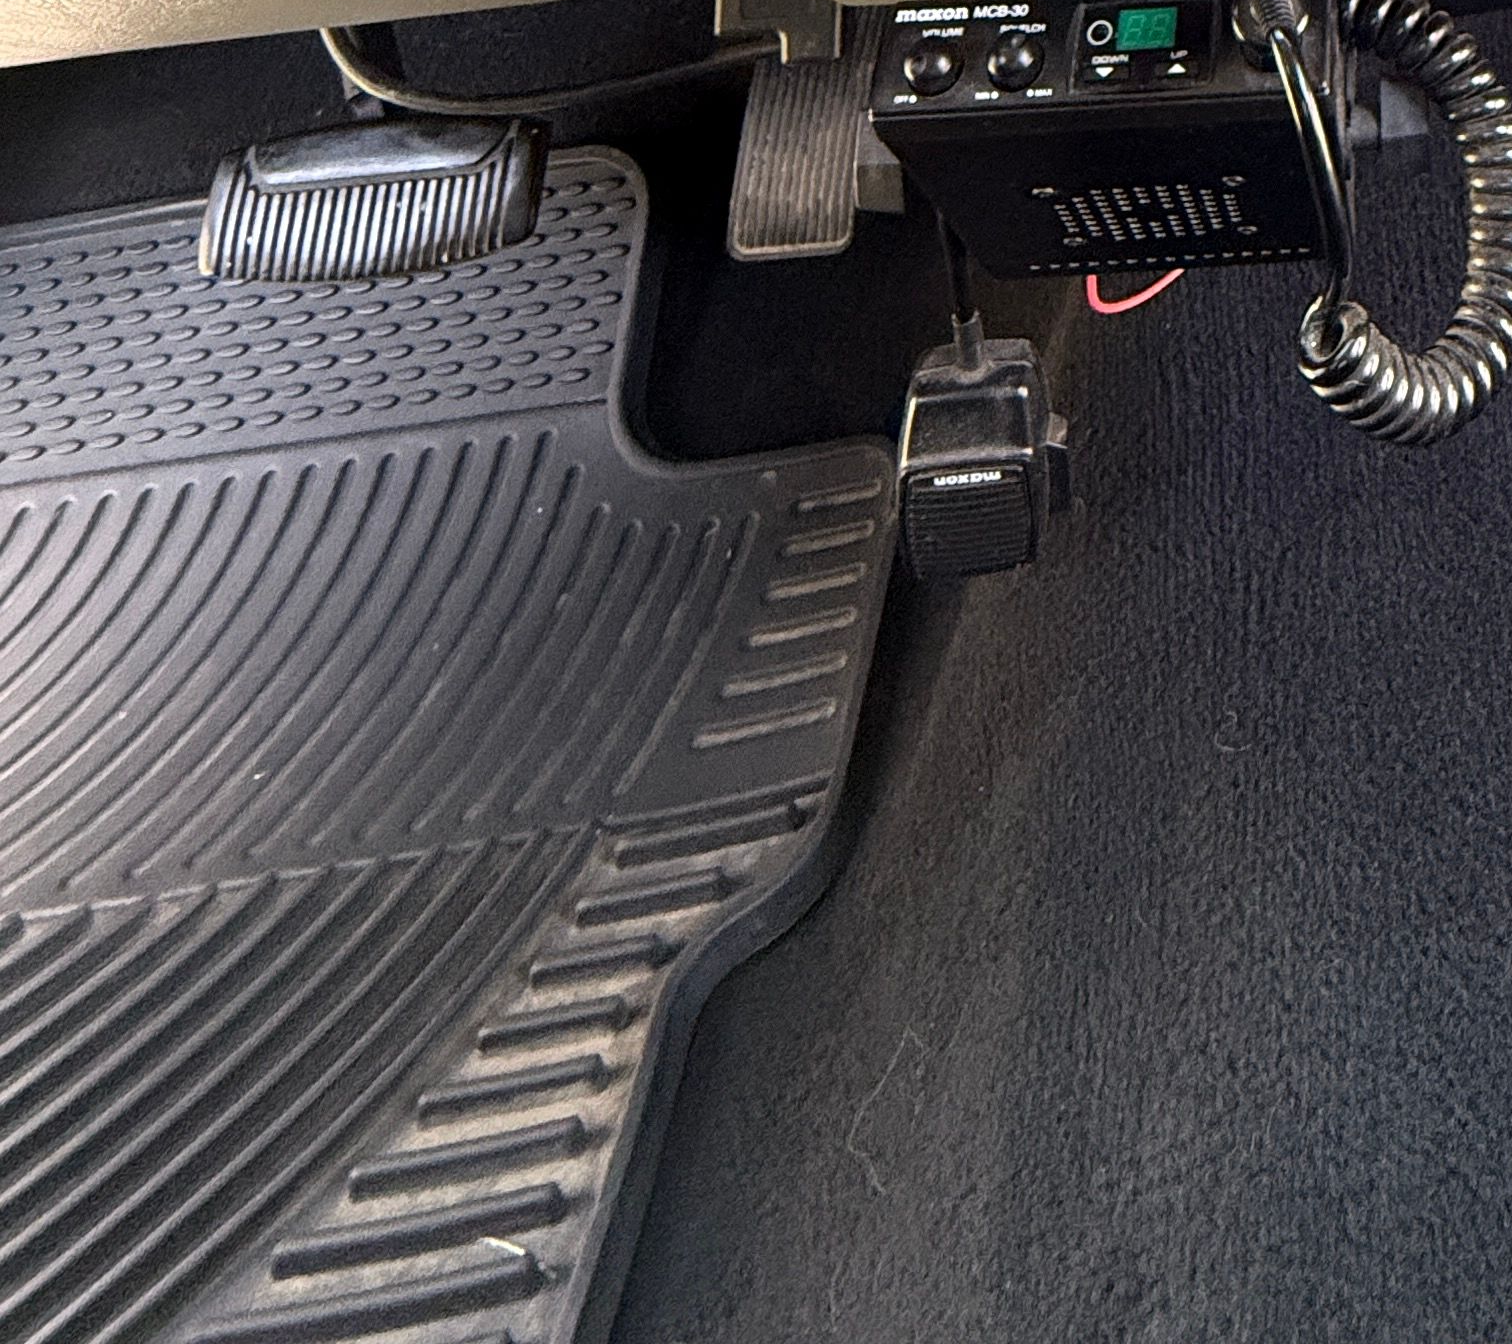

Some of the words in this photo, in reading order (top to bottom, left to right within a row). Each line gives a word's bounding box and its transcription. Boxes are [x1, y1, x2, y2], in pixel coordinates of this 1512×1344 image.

[895, 6, 969, 23] maxon
[973, 4, 1030, 19] MCB-30
[1091, 54, 1130, 65] DOWN
[1170, 50, 1188, 60] UP
[934, 470, 1002, 487] maxon
